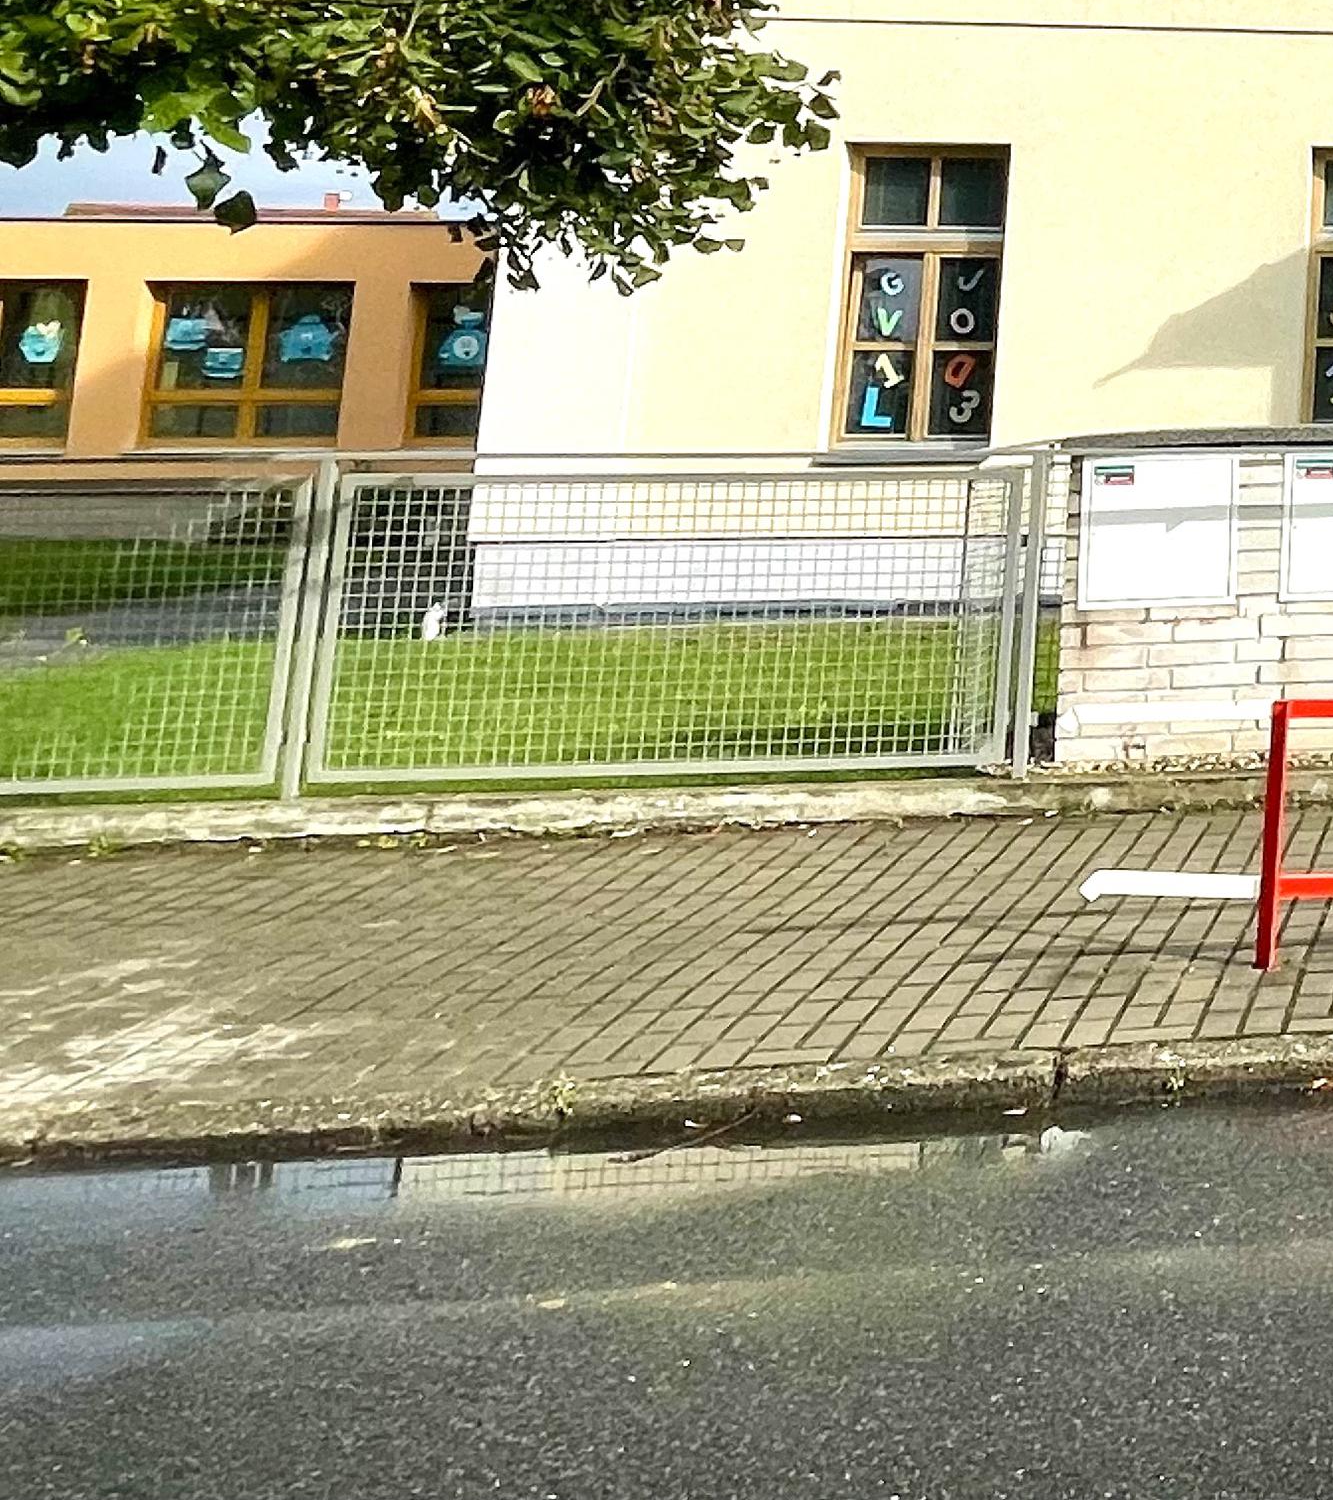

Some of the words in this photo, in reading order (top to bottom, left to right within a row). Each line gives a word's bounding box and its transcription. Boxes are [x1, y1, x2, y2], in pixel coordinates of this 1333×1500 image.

[880, 272, 905, 296] G
[877, 307, 903, 336] V
[875, 353, 905, 389] 1
[860, 386, 893, 428] L
[949, 389, 980, 424] 3
